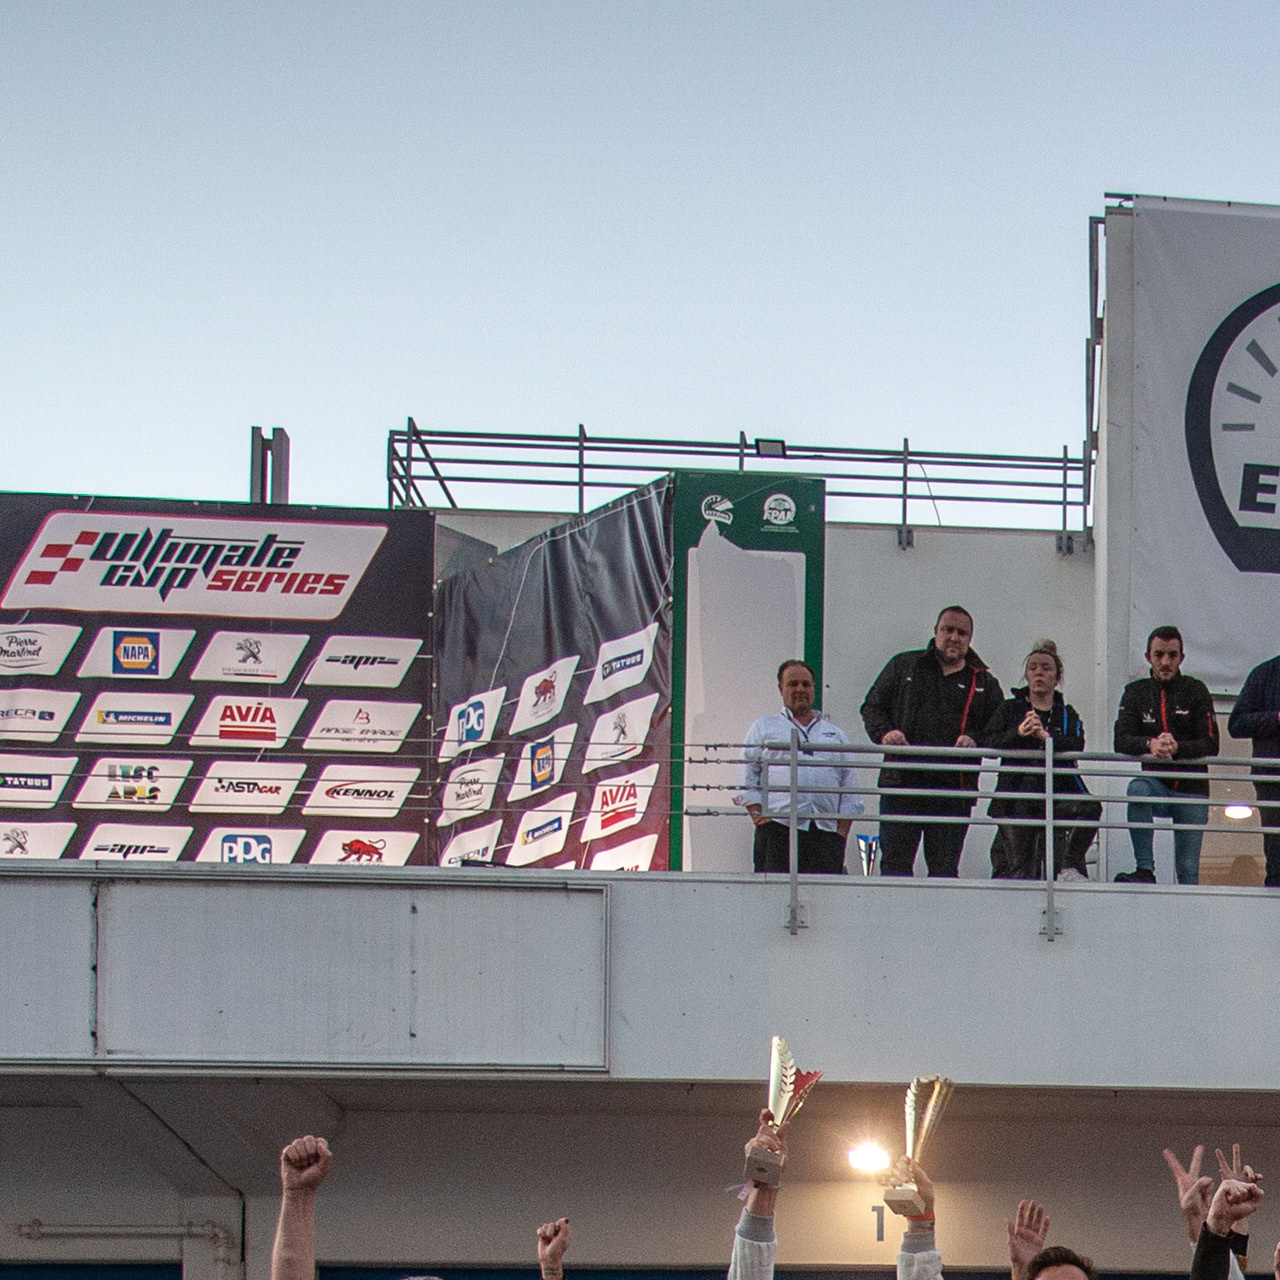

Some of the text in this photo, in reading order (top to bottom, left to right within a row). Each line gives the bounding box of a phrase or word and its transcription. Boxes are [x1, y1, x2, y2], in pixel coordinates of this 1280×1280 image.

[763, 509, 795, 521] FPAK
[122, 645, 149, 661] NAPA
[118, 714, 166, 723] MICHELIN
[4, 776, 49, 787] TATUUS
[330, 787, 396, 799] KENNOL
[223, 836, 270, 863] PPG
[871, 1206, 885, 1242] 1
